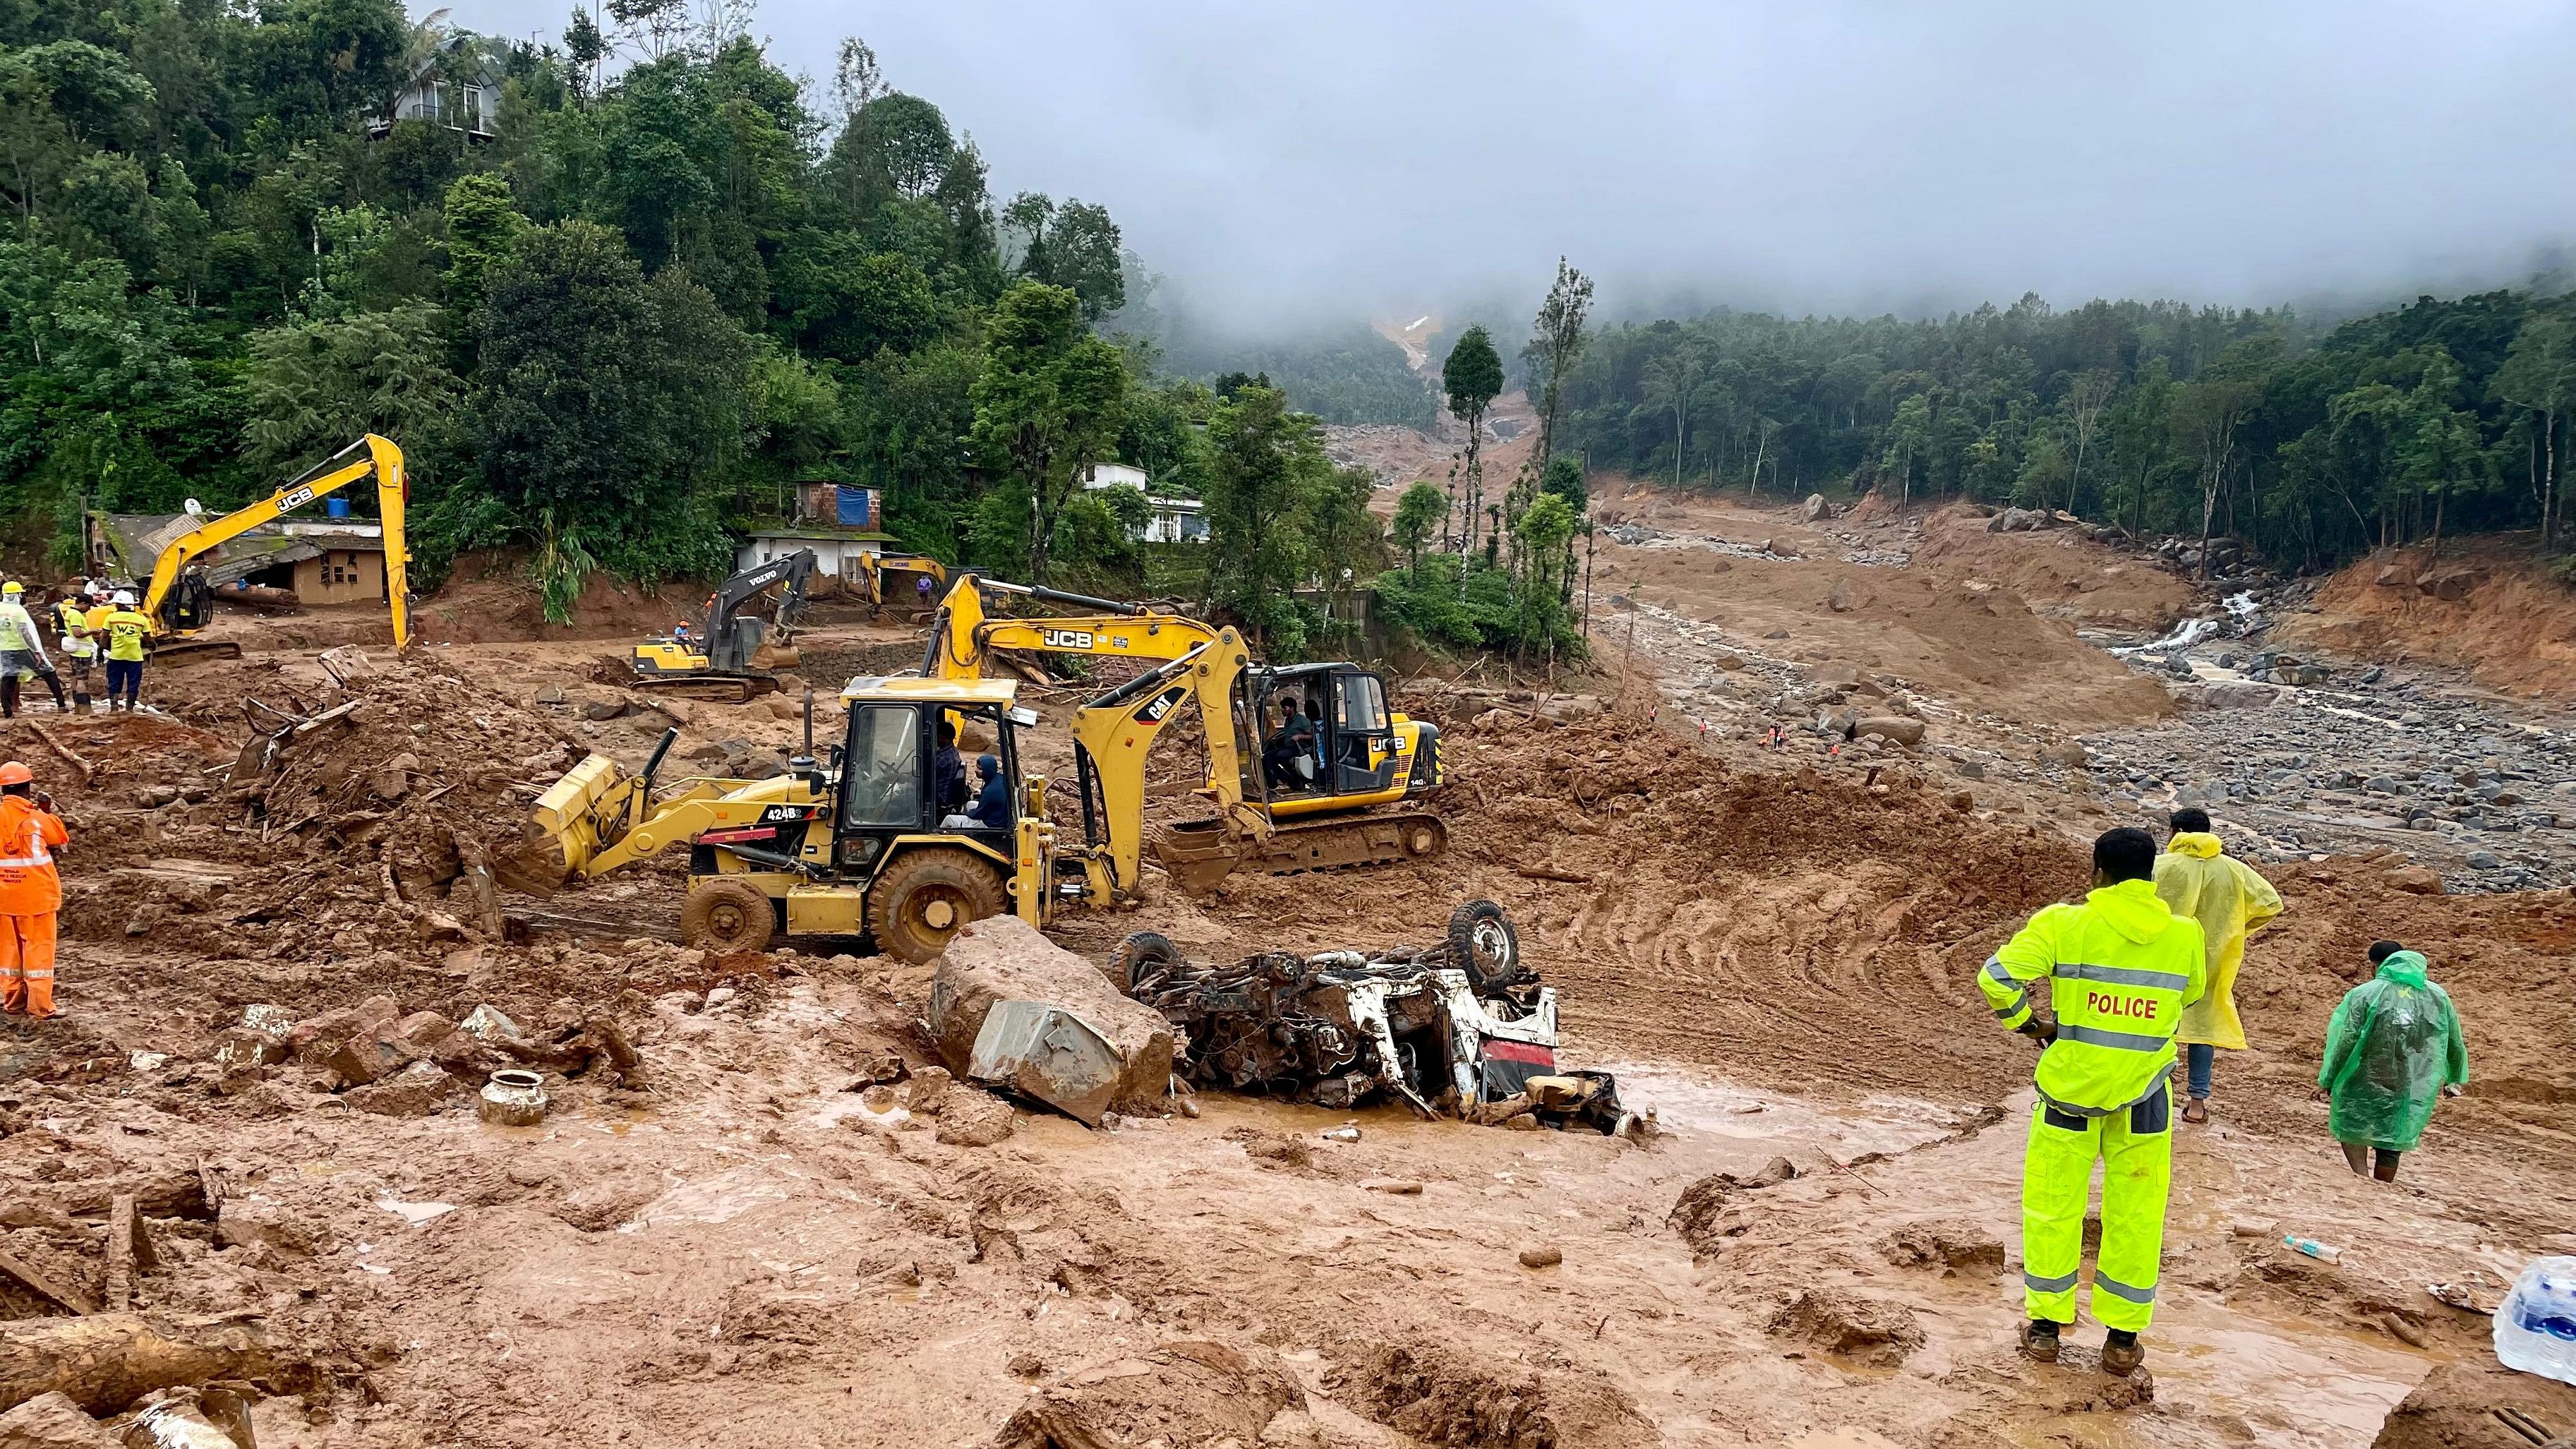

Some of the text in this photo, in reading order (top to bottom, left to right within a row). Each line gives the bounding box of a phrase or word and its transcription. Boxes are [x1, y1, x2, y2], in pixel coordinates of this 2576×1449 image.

[277, 488, 314, 511] JCB
[749, 570, 776, 586] VOLVO
[1045, 630, 1093, 648] JCB
[1148, 695, 1172, 719] CAT
[2087, 992, 2157, 1019] POLICE
